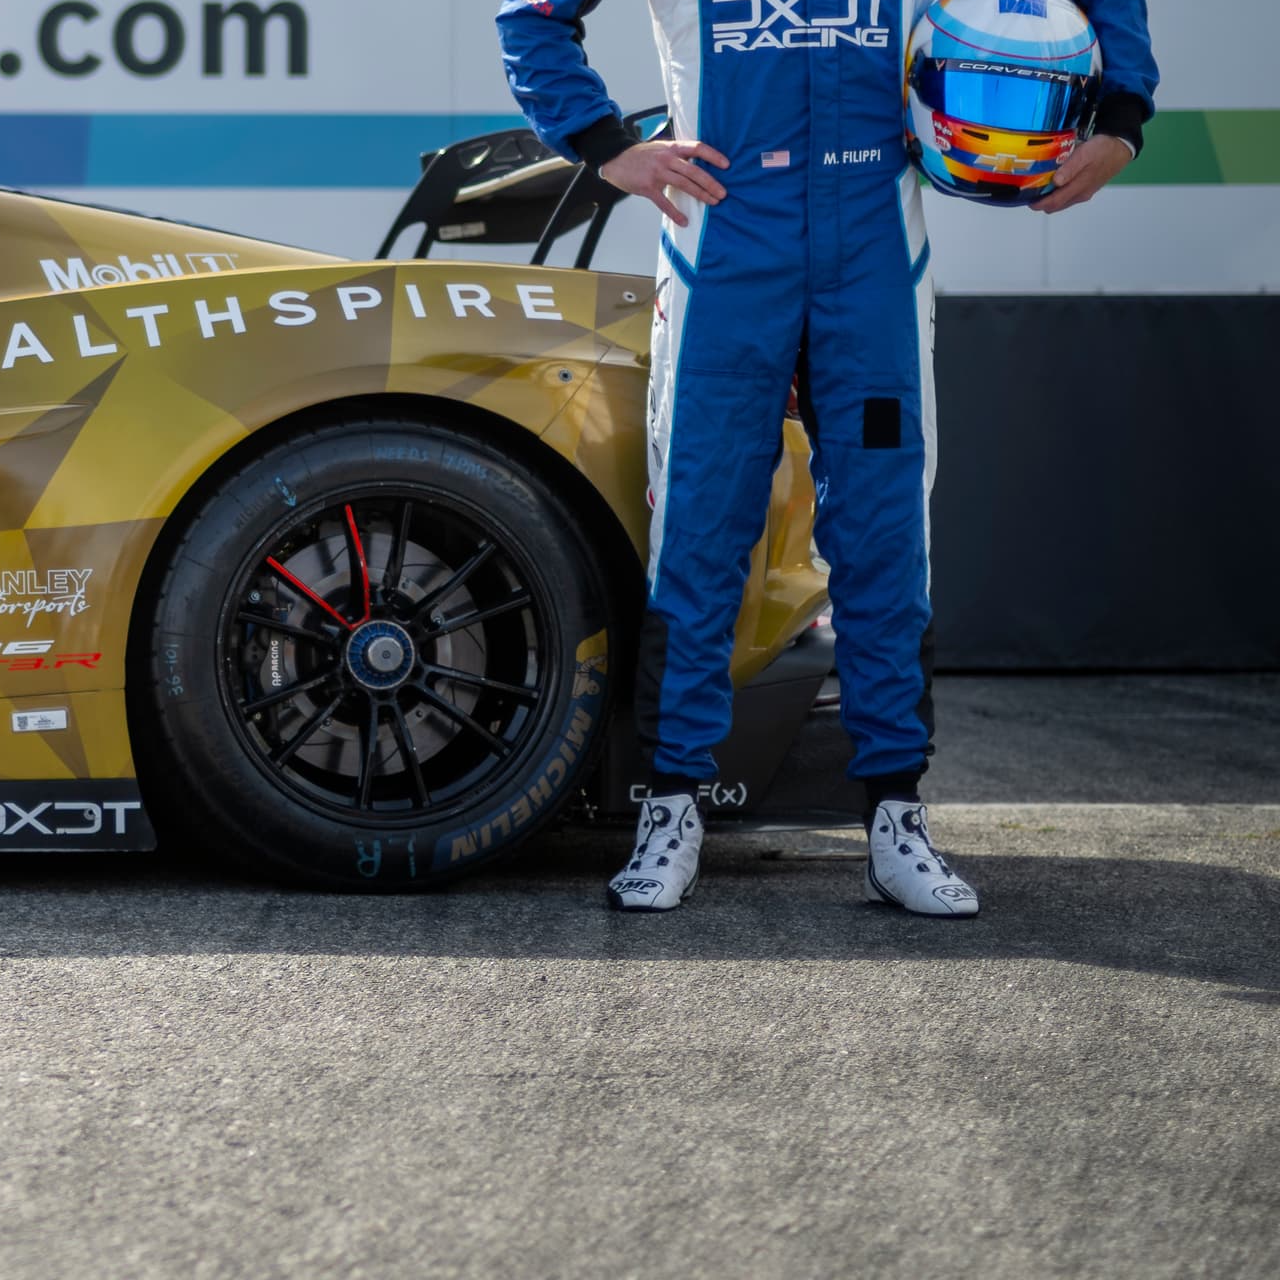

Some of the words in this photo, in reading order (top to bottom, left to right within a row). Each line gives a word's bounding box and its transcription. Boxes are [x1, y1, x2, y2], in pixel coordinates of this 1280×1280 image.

[712, 27, 890, 53] RACING
[958, 61, 1071, 82] CORVETTE
[823, 152, 840, 165] M.
[842, 148, 881, 163] FILIPPI
[39, 253, 184, 293] Mobil
[450, 706, 593, 862] MICHELIN
